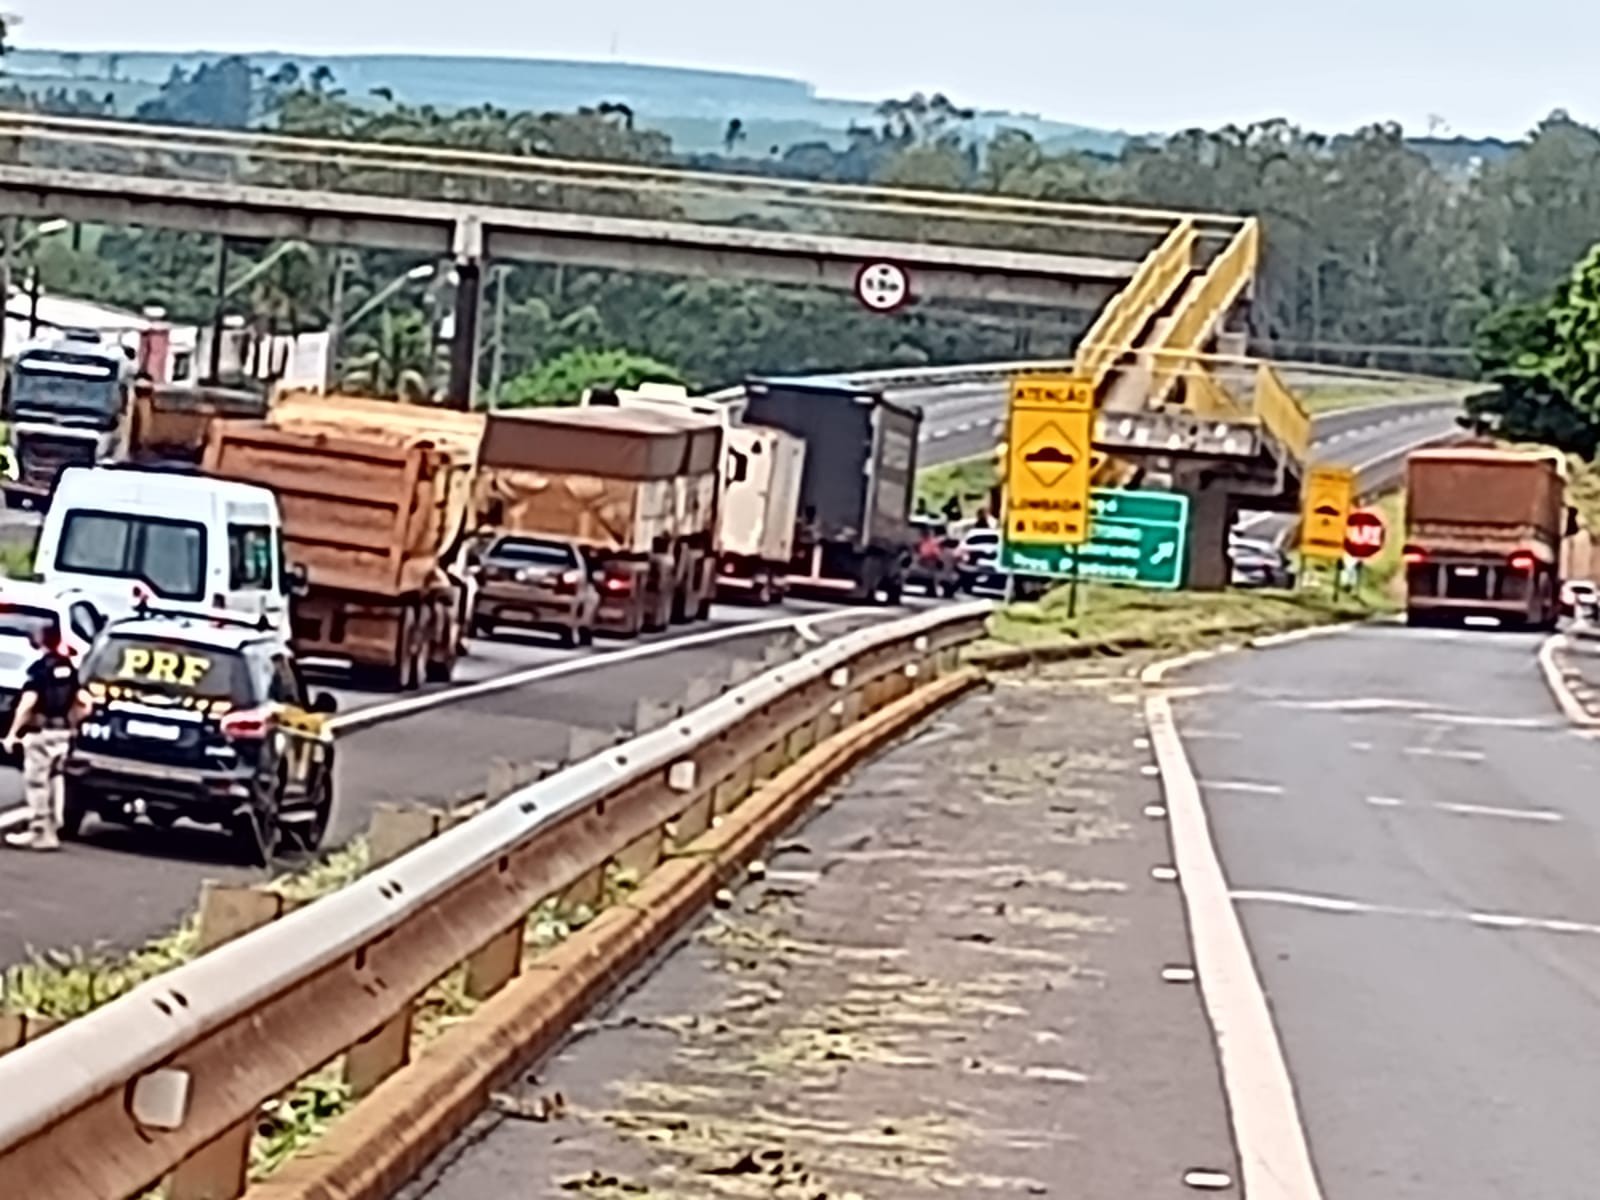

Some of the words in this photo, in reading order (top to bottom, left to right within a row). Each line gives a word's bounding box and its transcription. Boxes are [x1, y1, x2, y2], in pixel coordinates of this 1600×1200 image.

[1015, 386, 1087, 403] ATENÇÃO
[1009, 497, 1082, 512] LOMBADA
[118, 647, 211, 687] PRF
